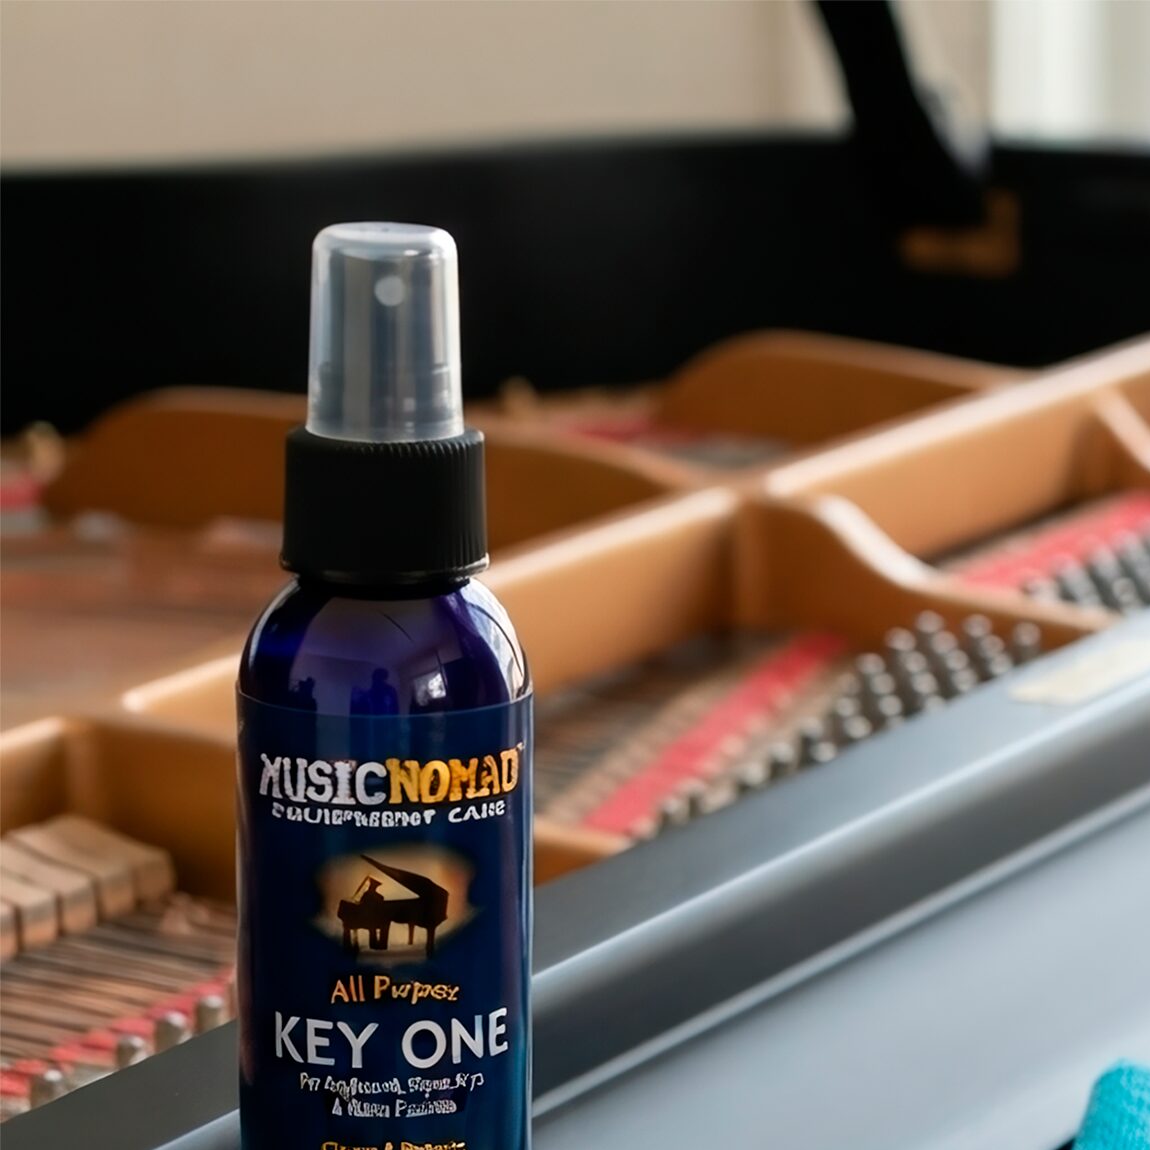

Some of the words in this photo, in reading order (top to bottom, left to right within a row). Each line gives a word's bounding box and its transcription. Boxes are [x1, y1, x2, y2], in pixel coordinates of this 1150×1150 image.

[331, 975, 365, 1004] All
[275, 1011, 379, 1069] KEY
[402, 1007, 508, 1069] ONE
